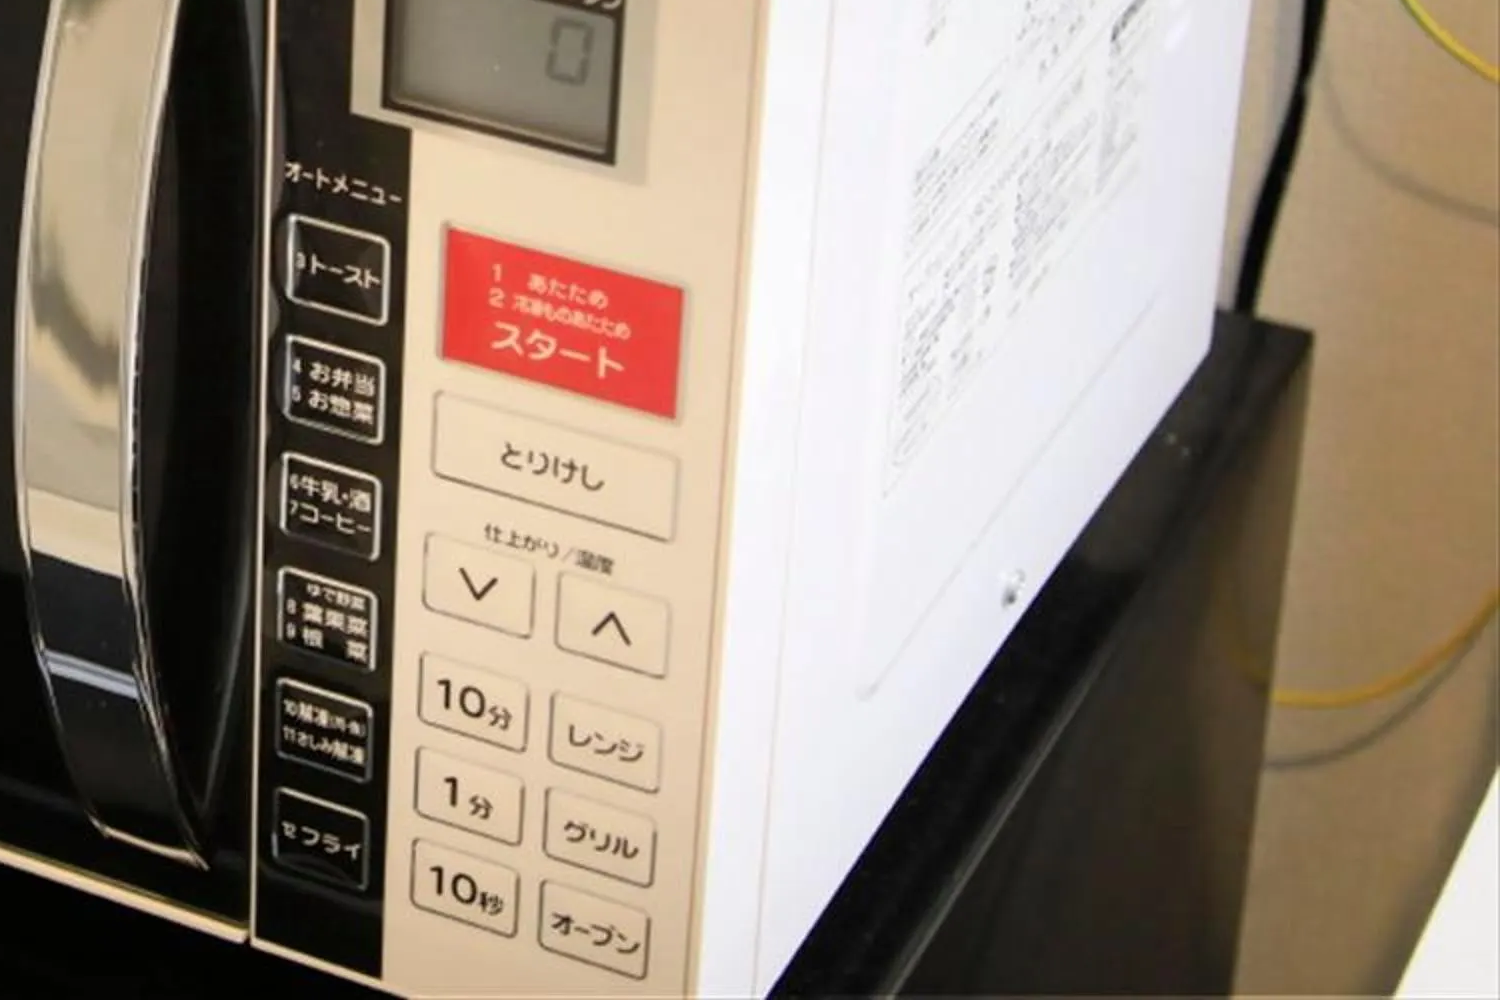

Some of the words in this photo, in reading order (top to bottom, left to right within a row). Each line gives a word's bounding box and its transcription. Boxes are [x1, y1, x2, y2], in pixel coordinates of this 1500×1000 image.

[544, 14, 594, 86] 0
[284, 160, 402, 204] オートメニュー
[310, 253, 381, 290] トースト
[488, 287, 505, 309] 2
[490, 320, 626, 380] スタート
[308, 361, 376, 398] お弁当
[499, 440, 606, 492] とりけし
[299, 502, 372, 535] コーヒー
[436, 678, 513, 732] 10分
[567, 724, 646, 764] レンジ
[443, 776, 495, 821] 1分
[300, 824, 362, 861] フライ
[563, 819, 640, 860] グリル
[429, 865, 505, 917] 10秒
[550, 912, 642, 956] オープン
